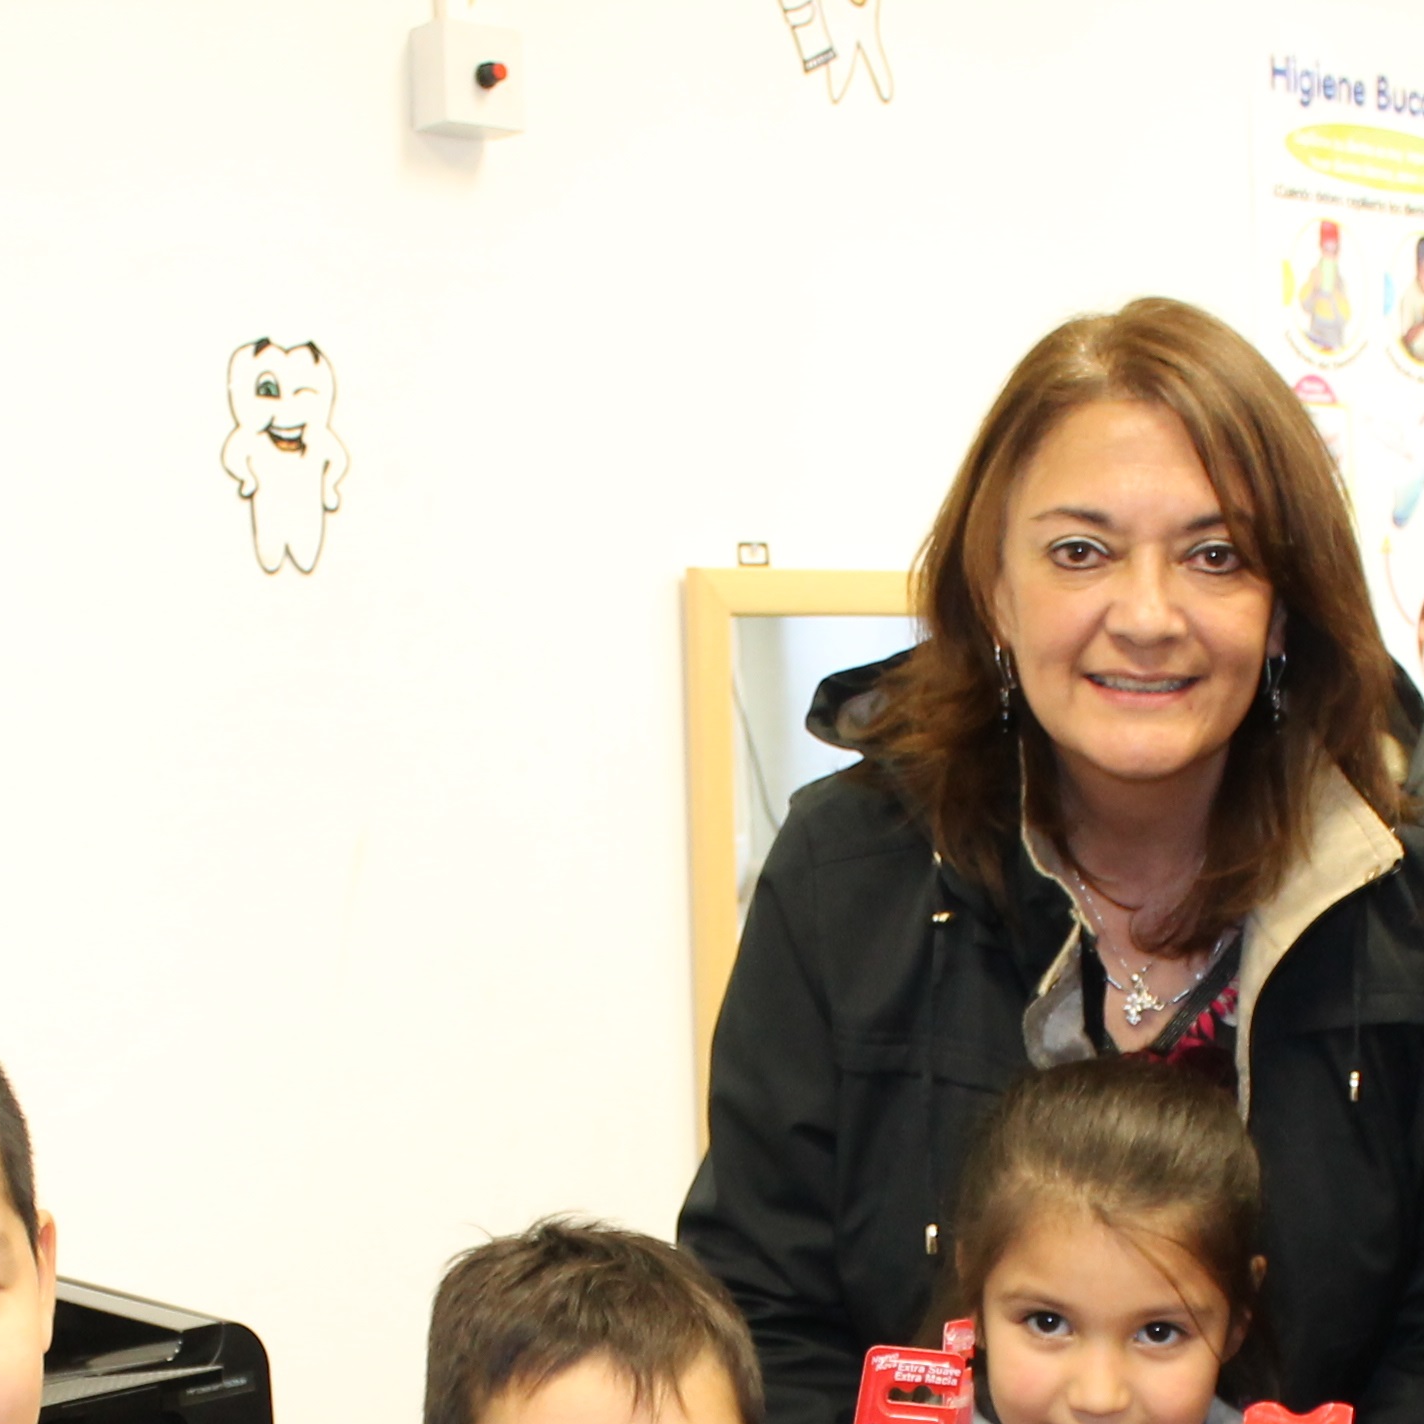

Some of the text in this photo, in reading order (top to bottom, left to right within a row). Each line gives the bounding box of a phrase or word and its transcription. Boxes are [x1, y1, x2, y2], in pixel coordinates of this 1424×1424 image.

[1270, 55, 1365, 107] Higiene
[894, 1370, 922, 1383] Extra
[897, 1362, 926, 1374] Extra
[927, 1365, 962, 1377] Suave
